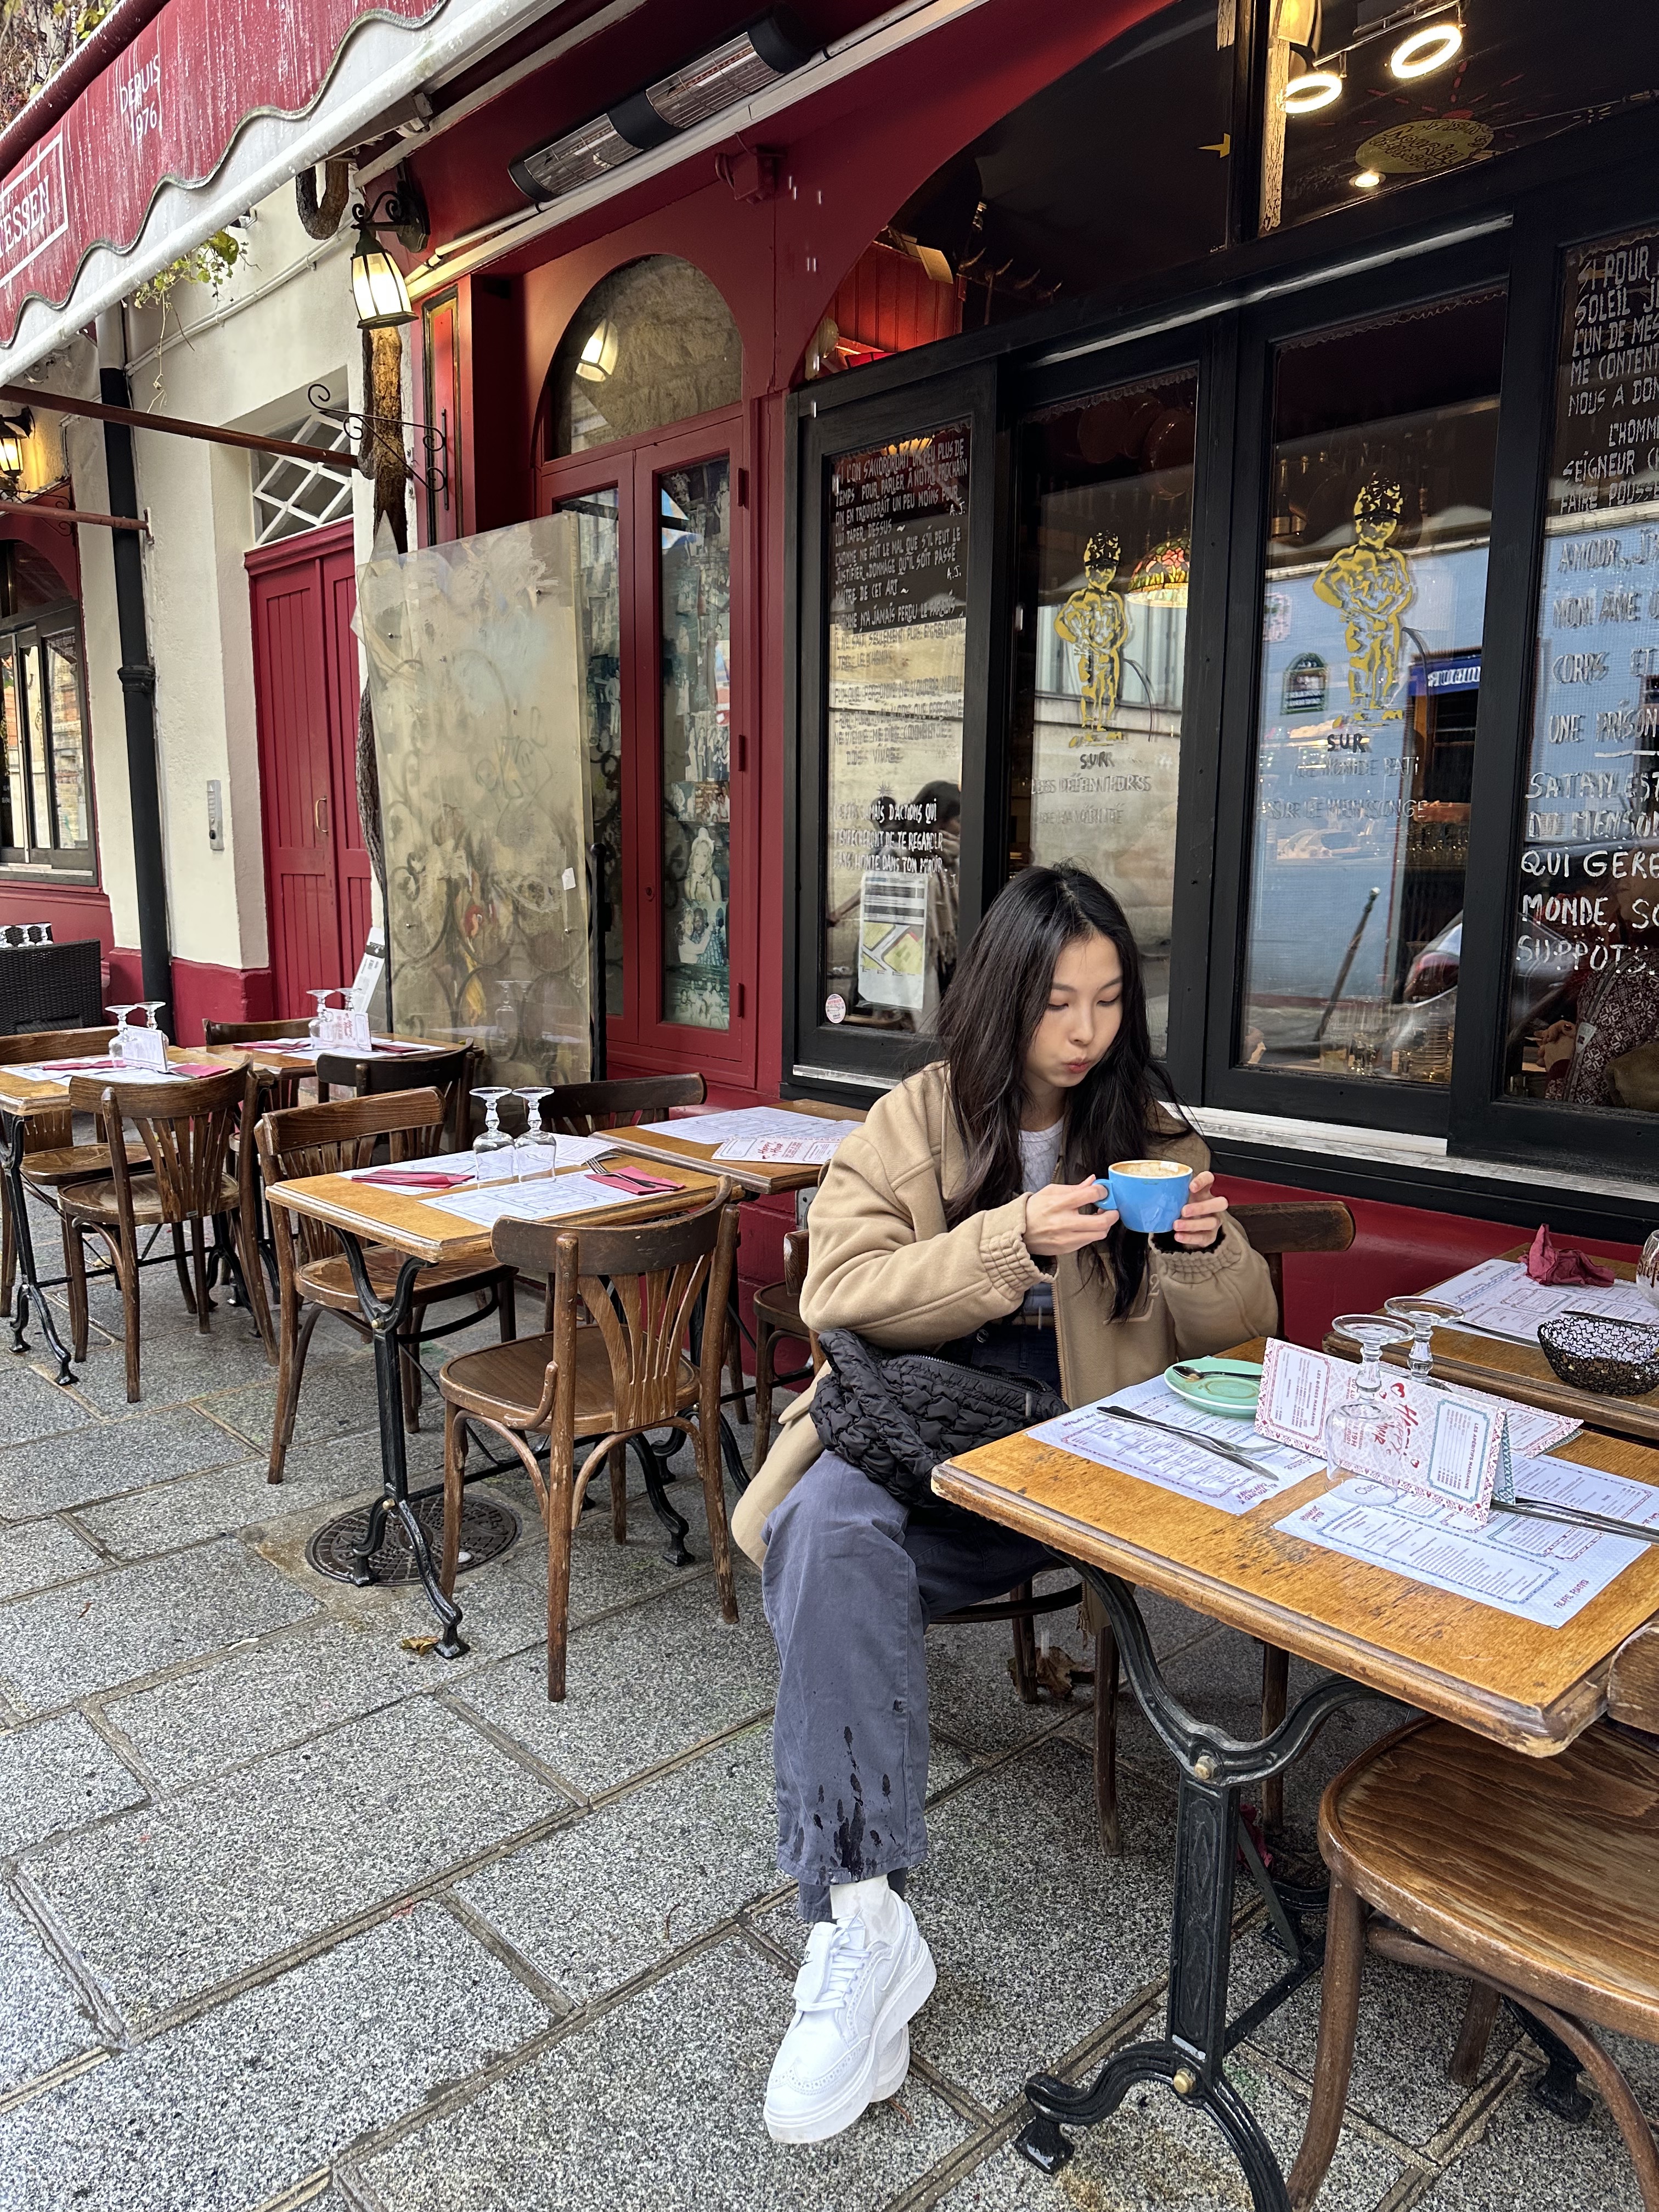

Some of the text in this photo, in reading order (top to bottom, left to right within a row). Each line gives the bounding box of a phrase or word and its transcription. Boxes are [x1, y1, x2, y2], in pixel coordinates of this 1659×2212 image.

[120, 54, 161, 114] DEPUIS
[129, 103, 157, 145] 1976
[1603, 245, 1650, 287] POUR
[1576, 283, 1630, 327] SOLEIL
[1572, 326, 1601, 358] L'UN
[1608, 321, 1625, 349] DE
[1570, 358, 1590, 387] ME
[1567, 388, 1607, 417] NOUS
[1612, 383, 1624, 409] A
[938, 440, 953, 461] PLUS
[954, 438, 964, 457] DE
[836, 487, 855, 507] TEMPS
[861, 481, 880, 501] POUR
[881, 473, 905, 495] PARLER
[914, 465, 936, 487] NOTRE
[937, 455, 967, 482] PROCHAIN
[1562, 450, 1635, 485] SEIGNEUR
[836, 484, 963, 527] ON EN TROUVERAIT UN PEU MOINS POUR
[1559, 485, 1598, 515] FAIRE
[835, 550, 857, 567] L'HOMME
[860, 548, 867, 561] NE
[869, 540, 882, 560] FAIT
[883, 541, 890, 557] LE
[891, 539, 904, 555] MAL
[905, 535, 918, 556] QUE
[934, 528, 950, 546] PEUT
[952, 527, 961, 544] LE
[836, 518, 893, 548] LUI TAPER DESSUS
[916, 549, 931, 571] SOIT
[934, 543, 956, 566] PASSÉ
[860, 585, 868, 601] DE
[871, 582, 882, 599] CET
[885, 579, 898, 596] ART
[860, 610, 871, 627] N'A
[872, 603, 895, 625] JAMAIS
[898, 603, 918, 623] PERDU
[921, 602, 928, 619] LE
[1327, 733, 1367, 753] SUR
[1548, 714, 1585, 745] UNE
[1525, 772, 1614, 799] SATAN
[925, 798, 937, 824] QUI
[898, 831, 907, 850] TE
[882, 854, 900, 873] DANS
[901, 856, 917, 874] TON
[1520, 845, 1569, 878] QUI
